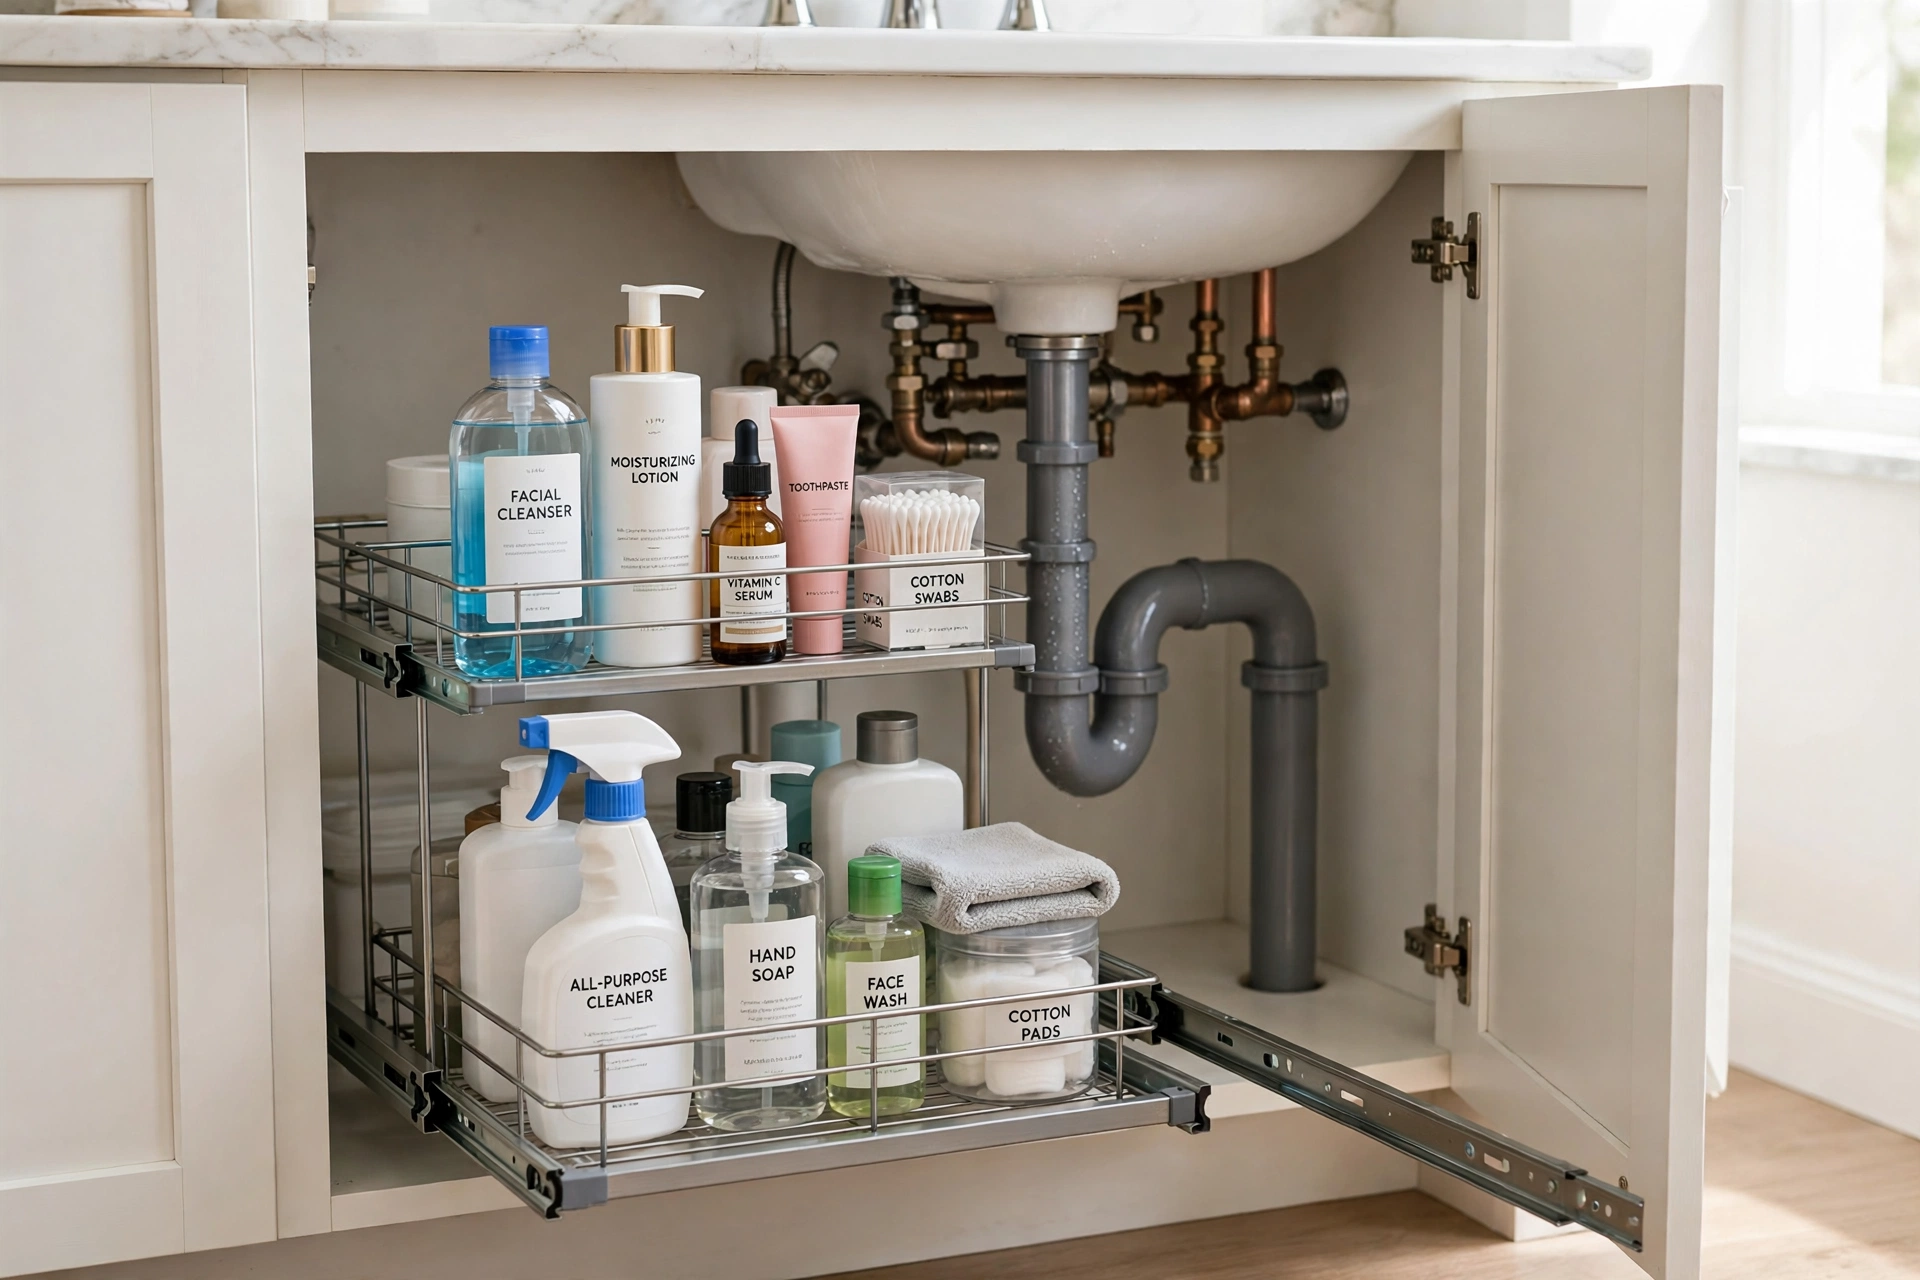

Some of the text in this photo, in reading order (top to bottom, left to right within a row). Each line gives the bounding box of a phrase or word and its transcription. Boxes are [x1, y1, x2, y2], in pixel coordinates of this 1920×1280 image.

[611, 454, 696, 468] MOISTURIZING
[631, 471, 679, 484] LOTION
[789, 481, 849, 492] TOOTHPASTE
[511, 488, 562, 503] FACIAL
[497, 504, 573, 521] CLEANSER
[727, 576, 781, 588] VITAMIN C
[910, 573, 964, 588] COTTON
[735, 590, 773, 601] SERUM
[915, 590, 960, 604] SWABS
[749, 946, 796, 963] HAND
[570, 968, 668, 992] ALL-PURPOSE
[752, 965, 795, 982] SOAP
[868, 974, 905, 991] FACE
[587, 989, 654, 1009] CLEANER
[863, 992, 907, 1009] WASH
[1008, 1004, 1071, 1023] COTTON
[1022, 1025, 1061, 1041] PADS
